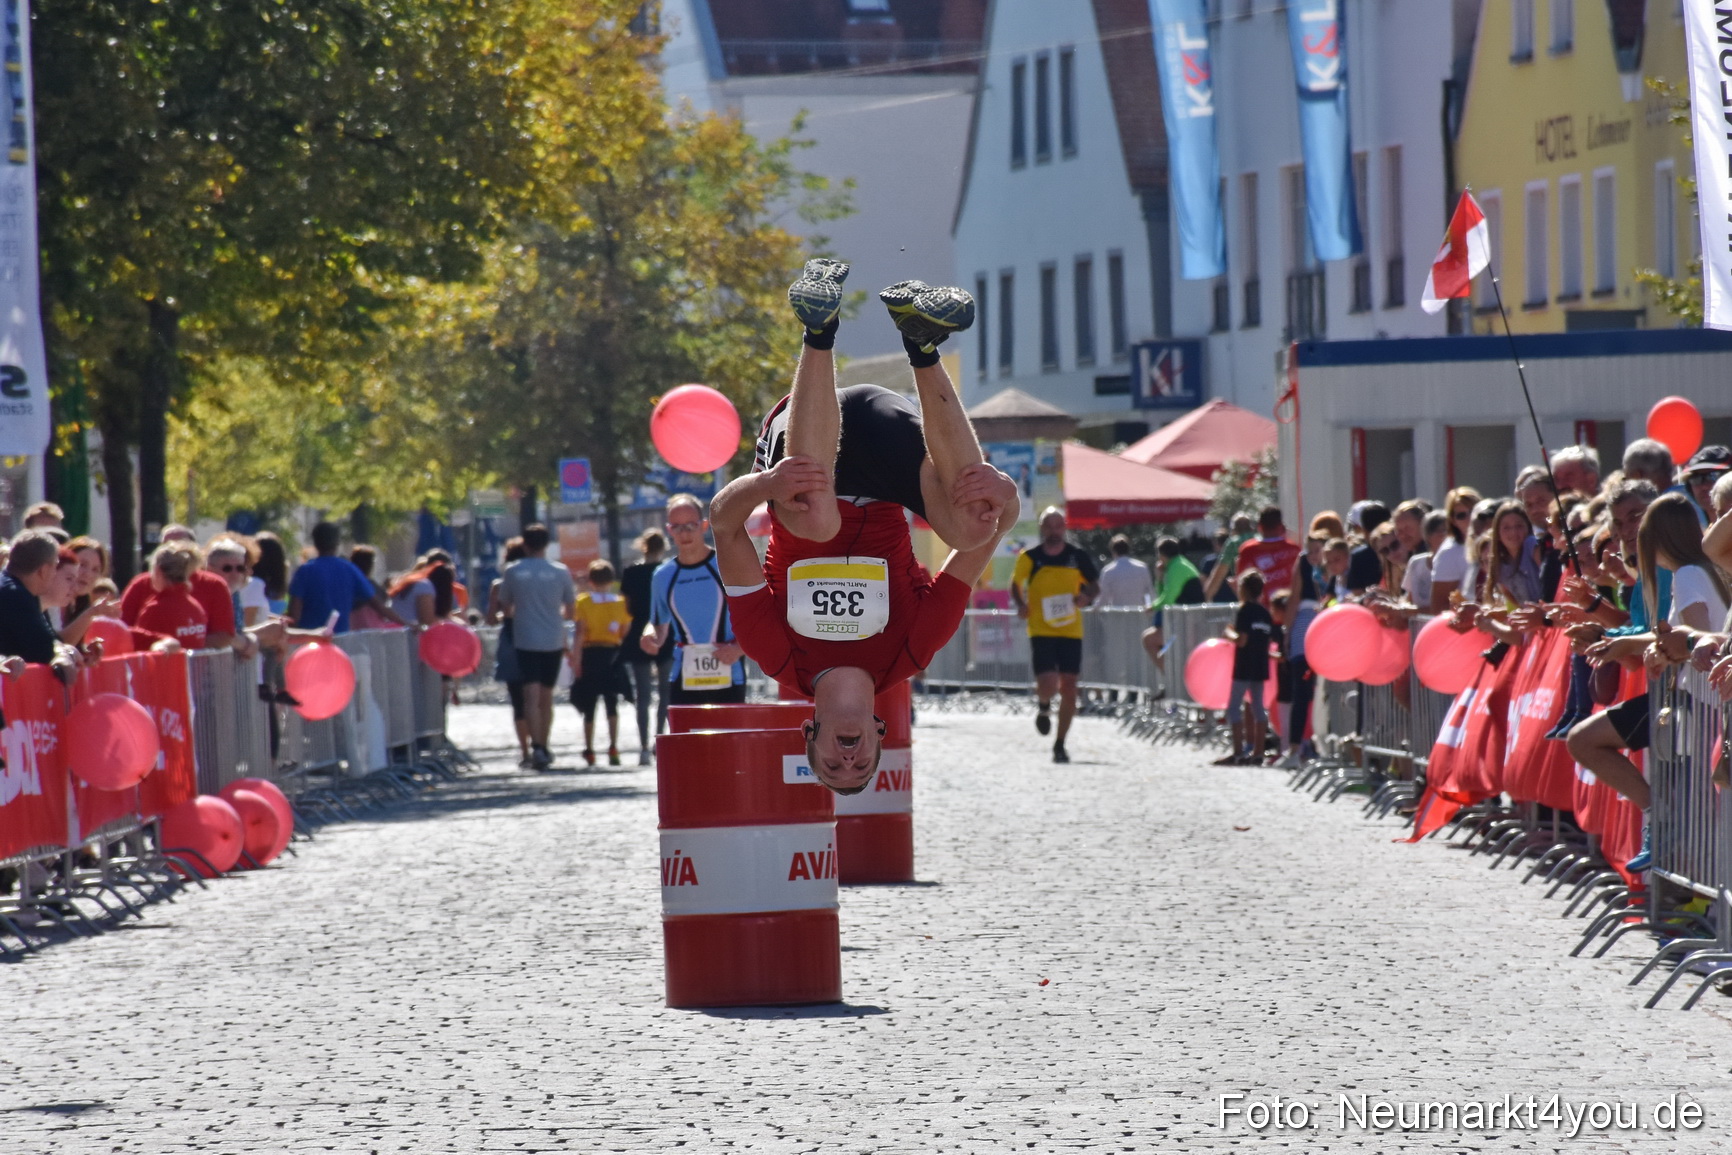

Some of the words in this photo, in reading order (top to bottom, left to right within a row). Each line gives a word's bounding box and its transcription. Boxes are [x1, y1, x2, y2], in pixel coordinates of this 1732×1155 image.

[1299, 0, 1341, 91] K&L
[1535, 114, 1578, 164] HOTEL
[812, 589, 865, 617] 335
[816, 623, 859, 634] BOCK
[693, 657, 719, 671] 160
